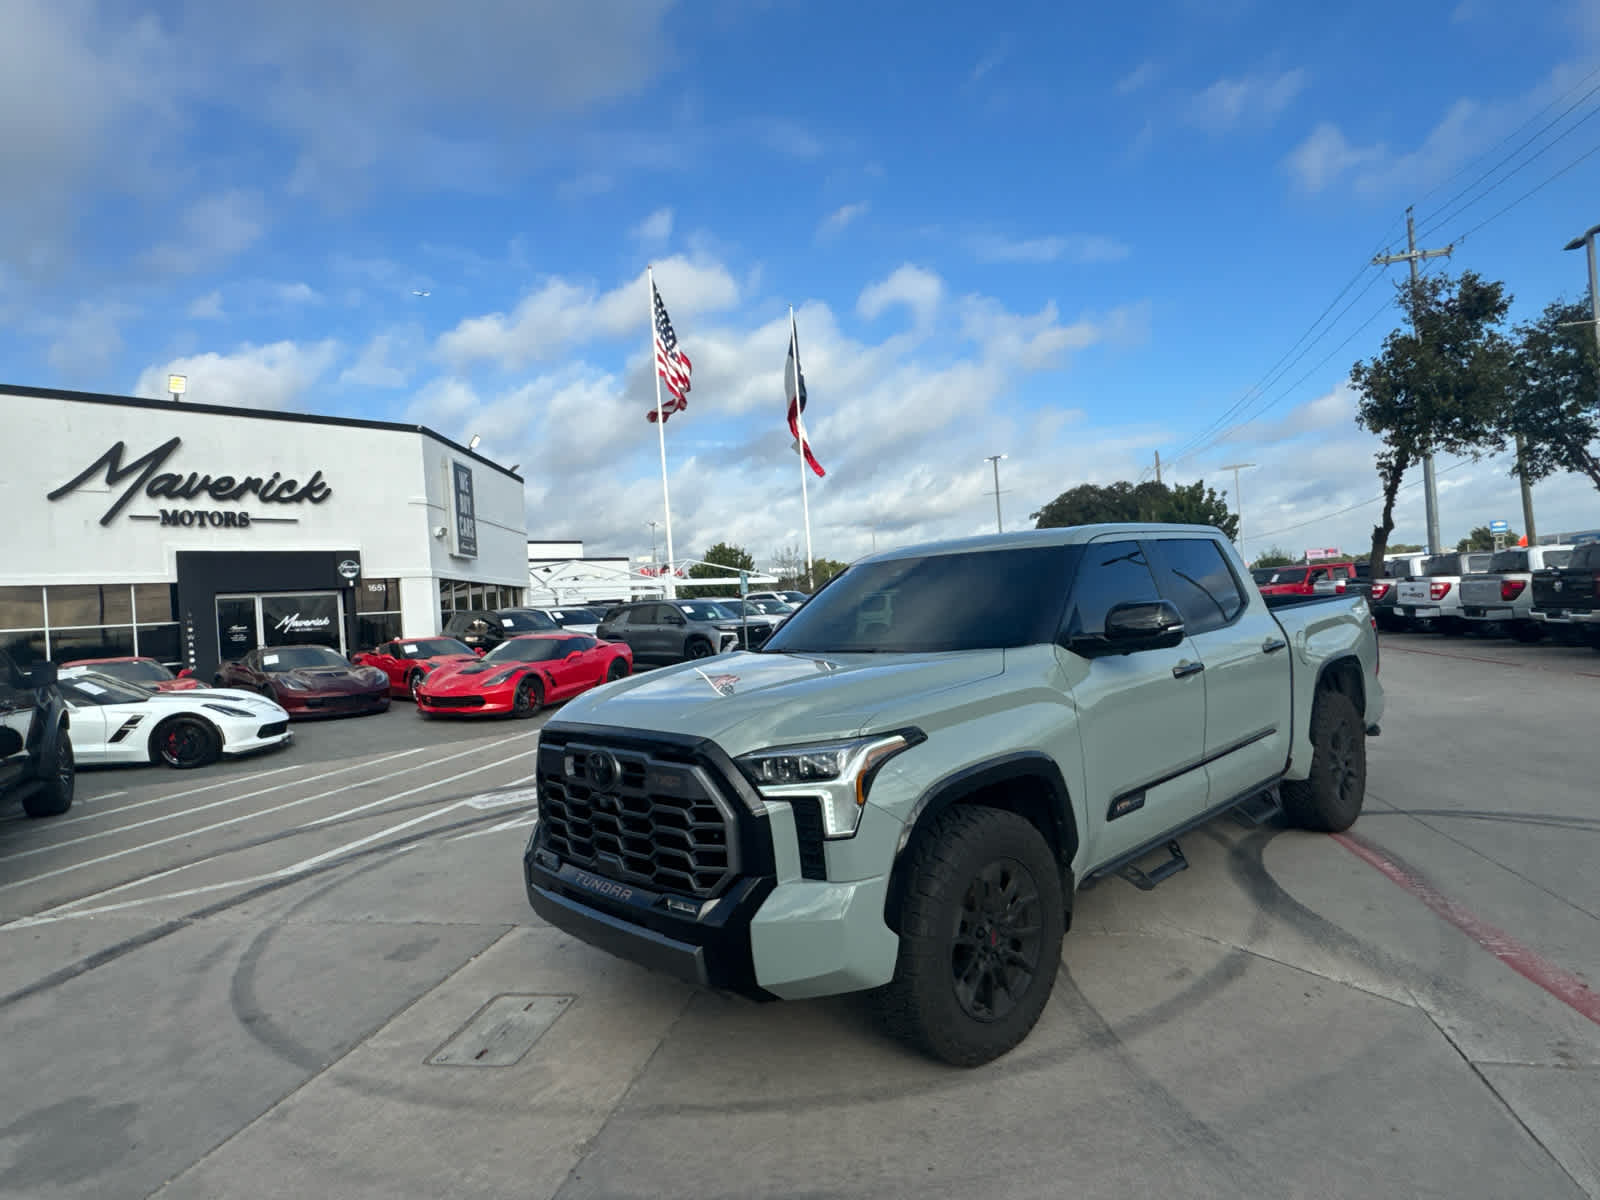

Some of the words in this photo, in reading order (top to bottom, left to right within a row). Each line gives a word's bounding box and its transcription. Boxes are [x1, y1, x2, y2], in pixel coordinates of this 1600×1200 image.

[47, 436, 332, 527] Maverick
[159, 508, 250, 528] MOTORS
[274, 612, 331, 634] Maverick
[575, 871, 633, 901] TUNDRA
